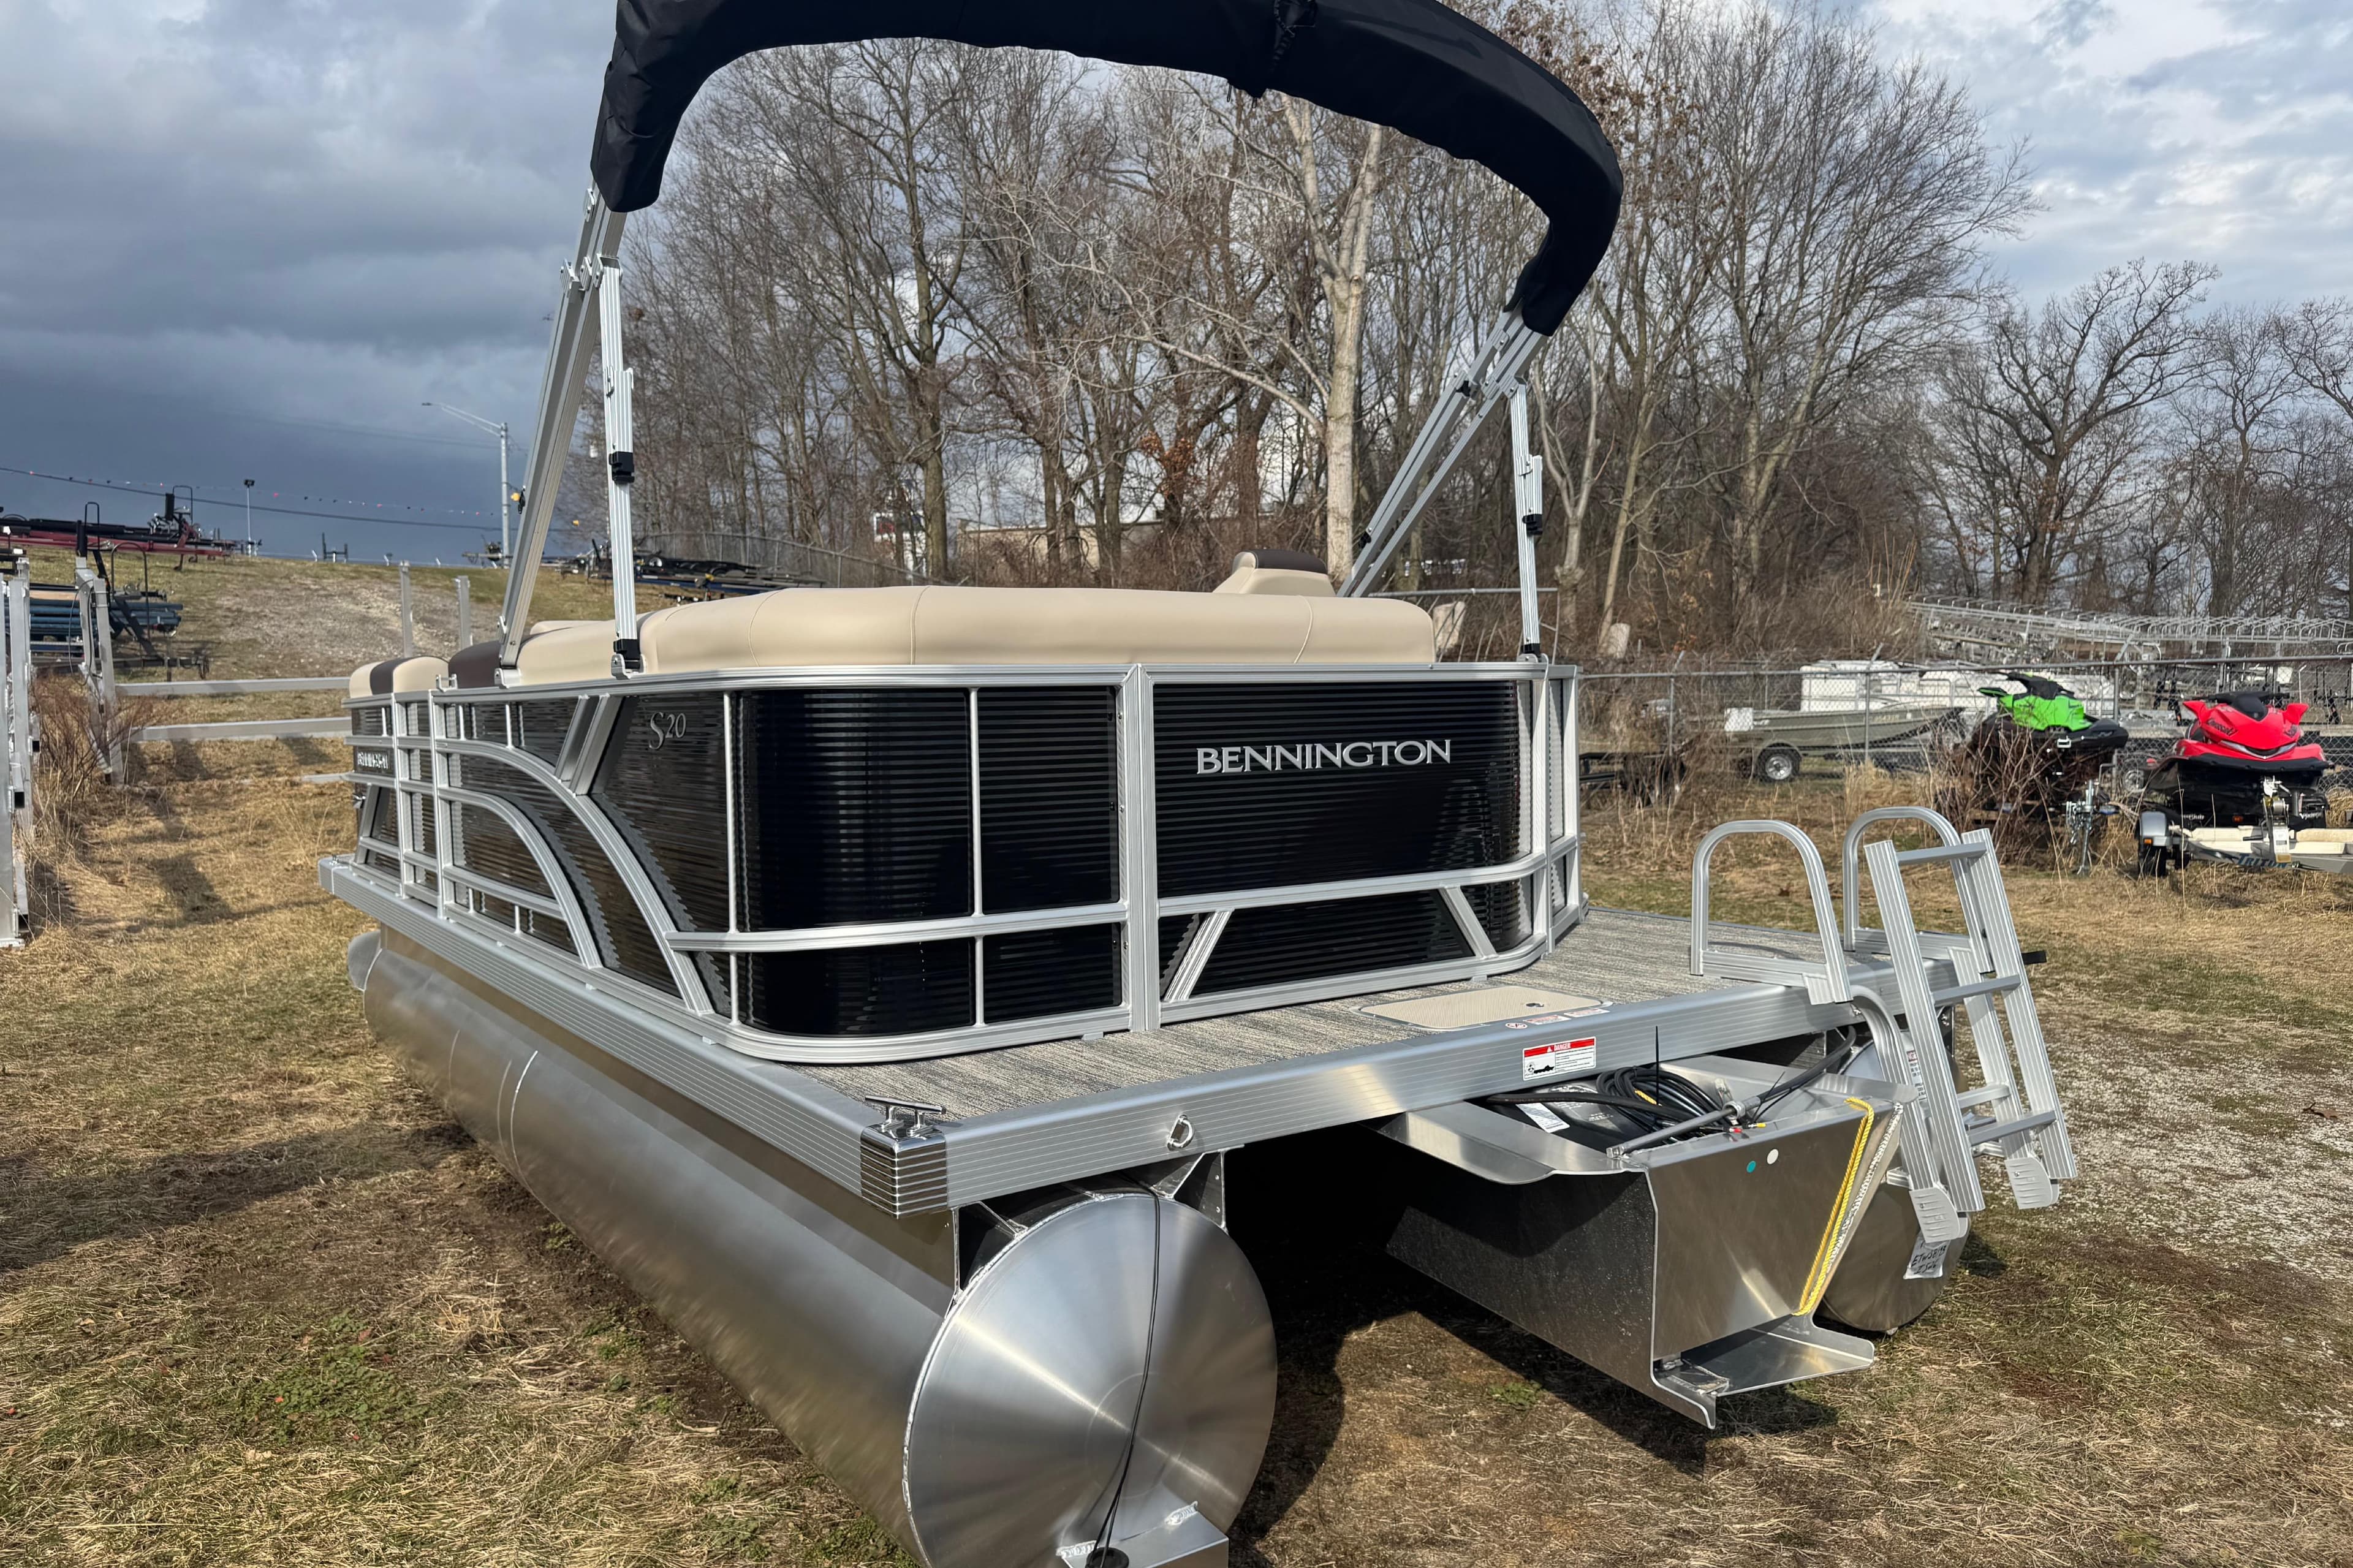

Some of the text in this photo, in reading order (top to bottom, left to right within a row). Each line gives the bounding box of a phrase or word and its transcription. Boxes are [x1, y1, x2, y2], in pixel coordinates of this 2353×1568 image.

[649, 711, 686, 749] S20
[1196, 739, 1451, 775] BENNINGTON
[1554, 1042, 1571, 1051] DANGER
